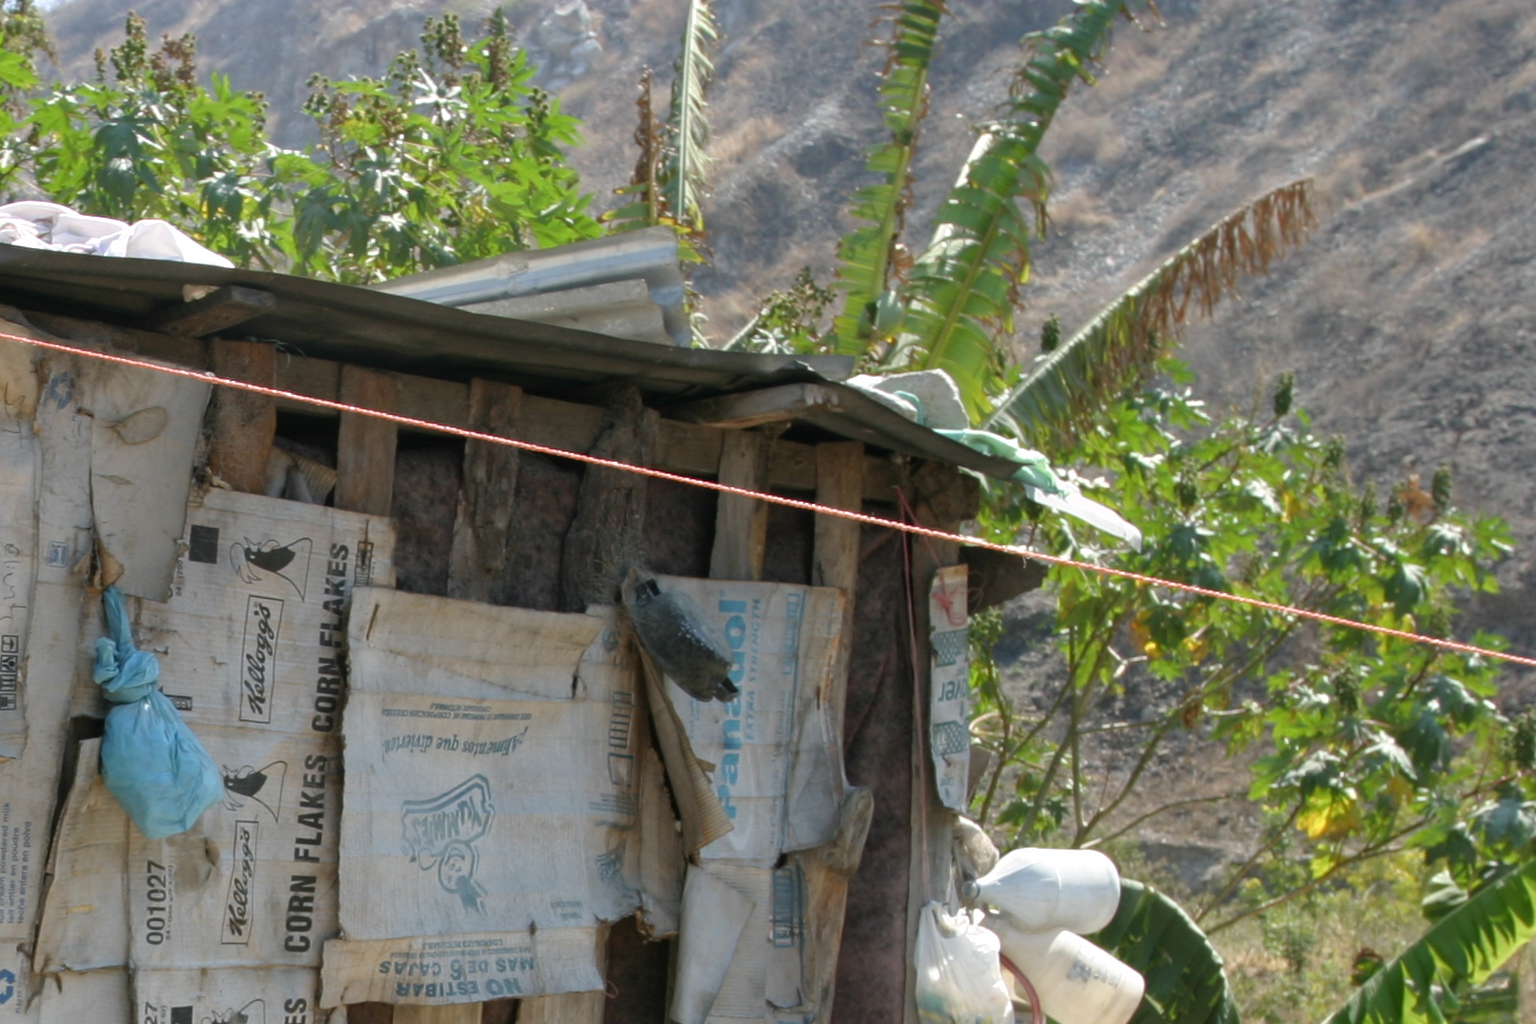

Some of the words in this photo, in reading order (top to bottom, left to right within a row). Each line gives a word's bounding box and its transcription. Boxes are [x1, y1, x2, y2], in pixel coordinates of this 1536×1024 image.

[318, 543, 348, 649] FLAKES
[747, 598, 761, 683] STRENGTH
[244, 603, 274, 715] Kellogg's
[311, 657, 343, 732] CORN
[744, 690, 755, 740] EXTRA
[438, 734, 459, 753] que
[294, 755, 327, 863] FLAKES
[0, 825, 8, 874] powdered
[10, 827, 21, 862] poudre
[23, 821, 33, 848] polvo
[19, 866, 28, 896] entera
[228, 826, 253, 937] Kellogg's
[17, 898, 25, 924] leche
[146, 861, 166, 945] 001027
[284, 875, 317, 953] CORN
[378, 961, 442, 977] CAJAS
[450, 959, 463, 981] 6
[468, 959, 489, 974] DE
[495, 957, 535, 973] MAS
[395, 981, 478, 998] ESTIBAR
[485, 978, 522, 996] NO
